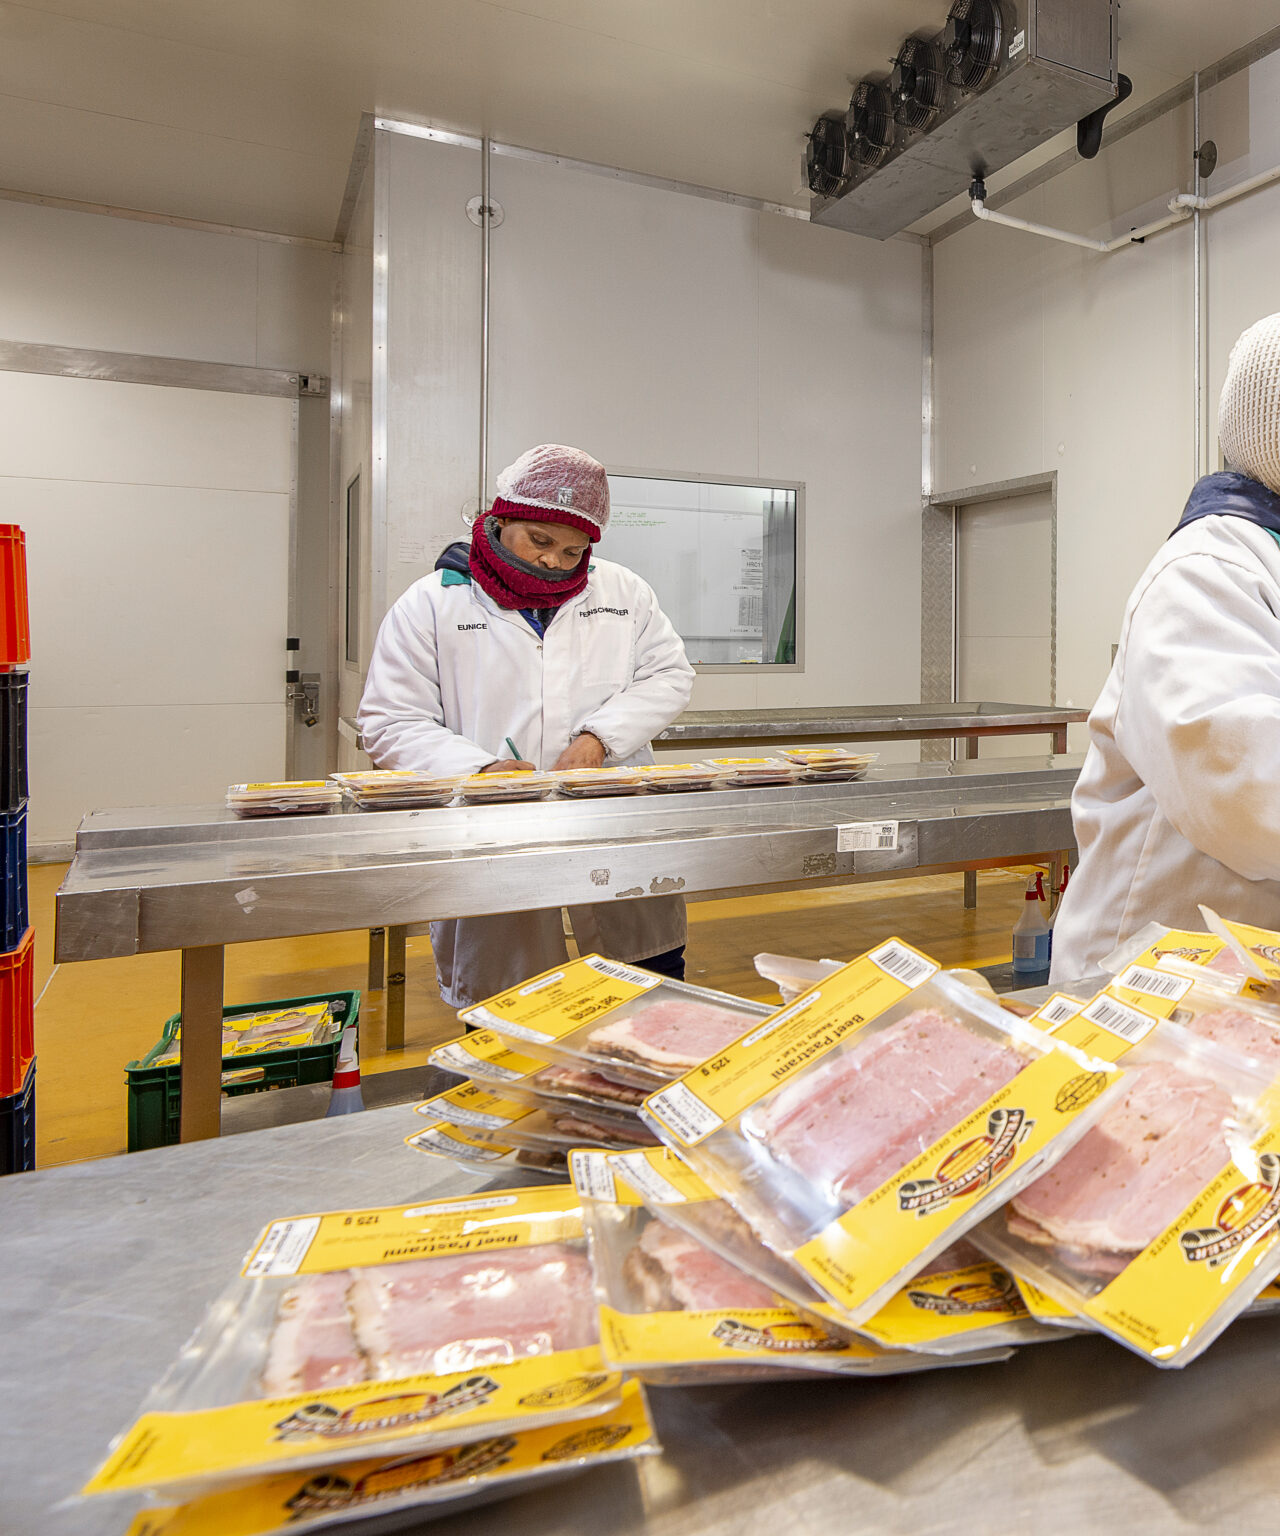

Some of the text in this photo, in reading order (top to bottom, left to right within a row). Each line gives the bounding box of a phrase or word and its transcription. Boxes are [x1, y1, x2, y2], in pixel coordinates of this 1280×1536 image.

[457, 623, 488, 631] EUNICE
[834, 1014, 865, 1039] Beef
[701, 1056, 731, 1077] 125 g
[771, 1035, 834, 1080] Pastrami
[953, 1088, 1012, 1137] CONTINENTAL
[930, 1137, 951, 1155] DELI
[1222, 1132, 1276, 1182] CONTTAL
[1203, 1181, 1223, 1201] DELI
[357, 1214, 379, 1227] 125
[1150, 1200, 1204, 1257] SPECIALISTS
